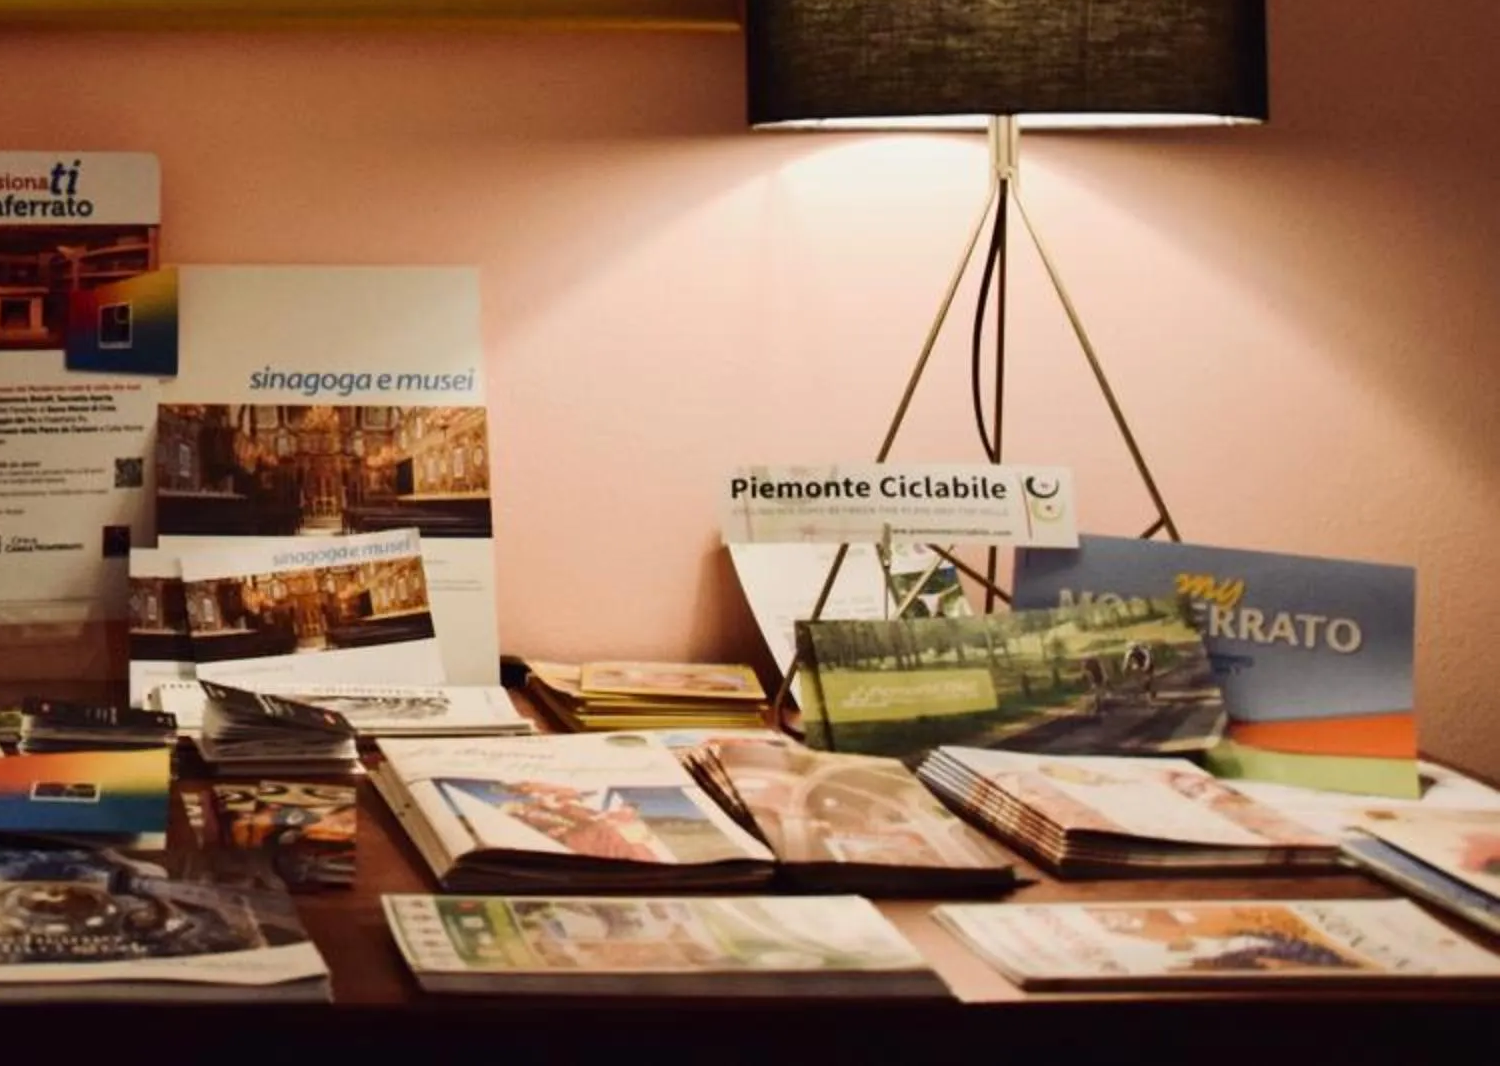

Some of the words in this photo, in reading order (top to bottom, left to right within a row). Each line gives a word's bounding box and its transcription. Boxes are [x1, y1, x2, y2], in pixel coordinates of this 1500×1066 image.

[249, 365, 372, 395] sinagoga
[377, 374, 392, 390] e
[396, 368, 474, 392] musei
[731, 475, 871, 500] Piemonte
[879, 475, 1008, 500] Ciclabile
[1175, 572, 1245, 610] my
